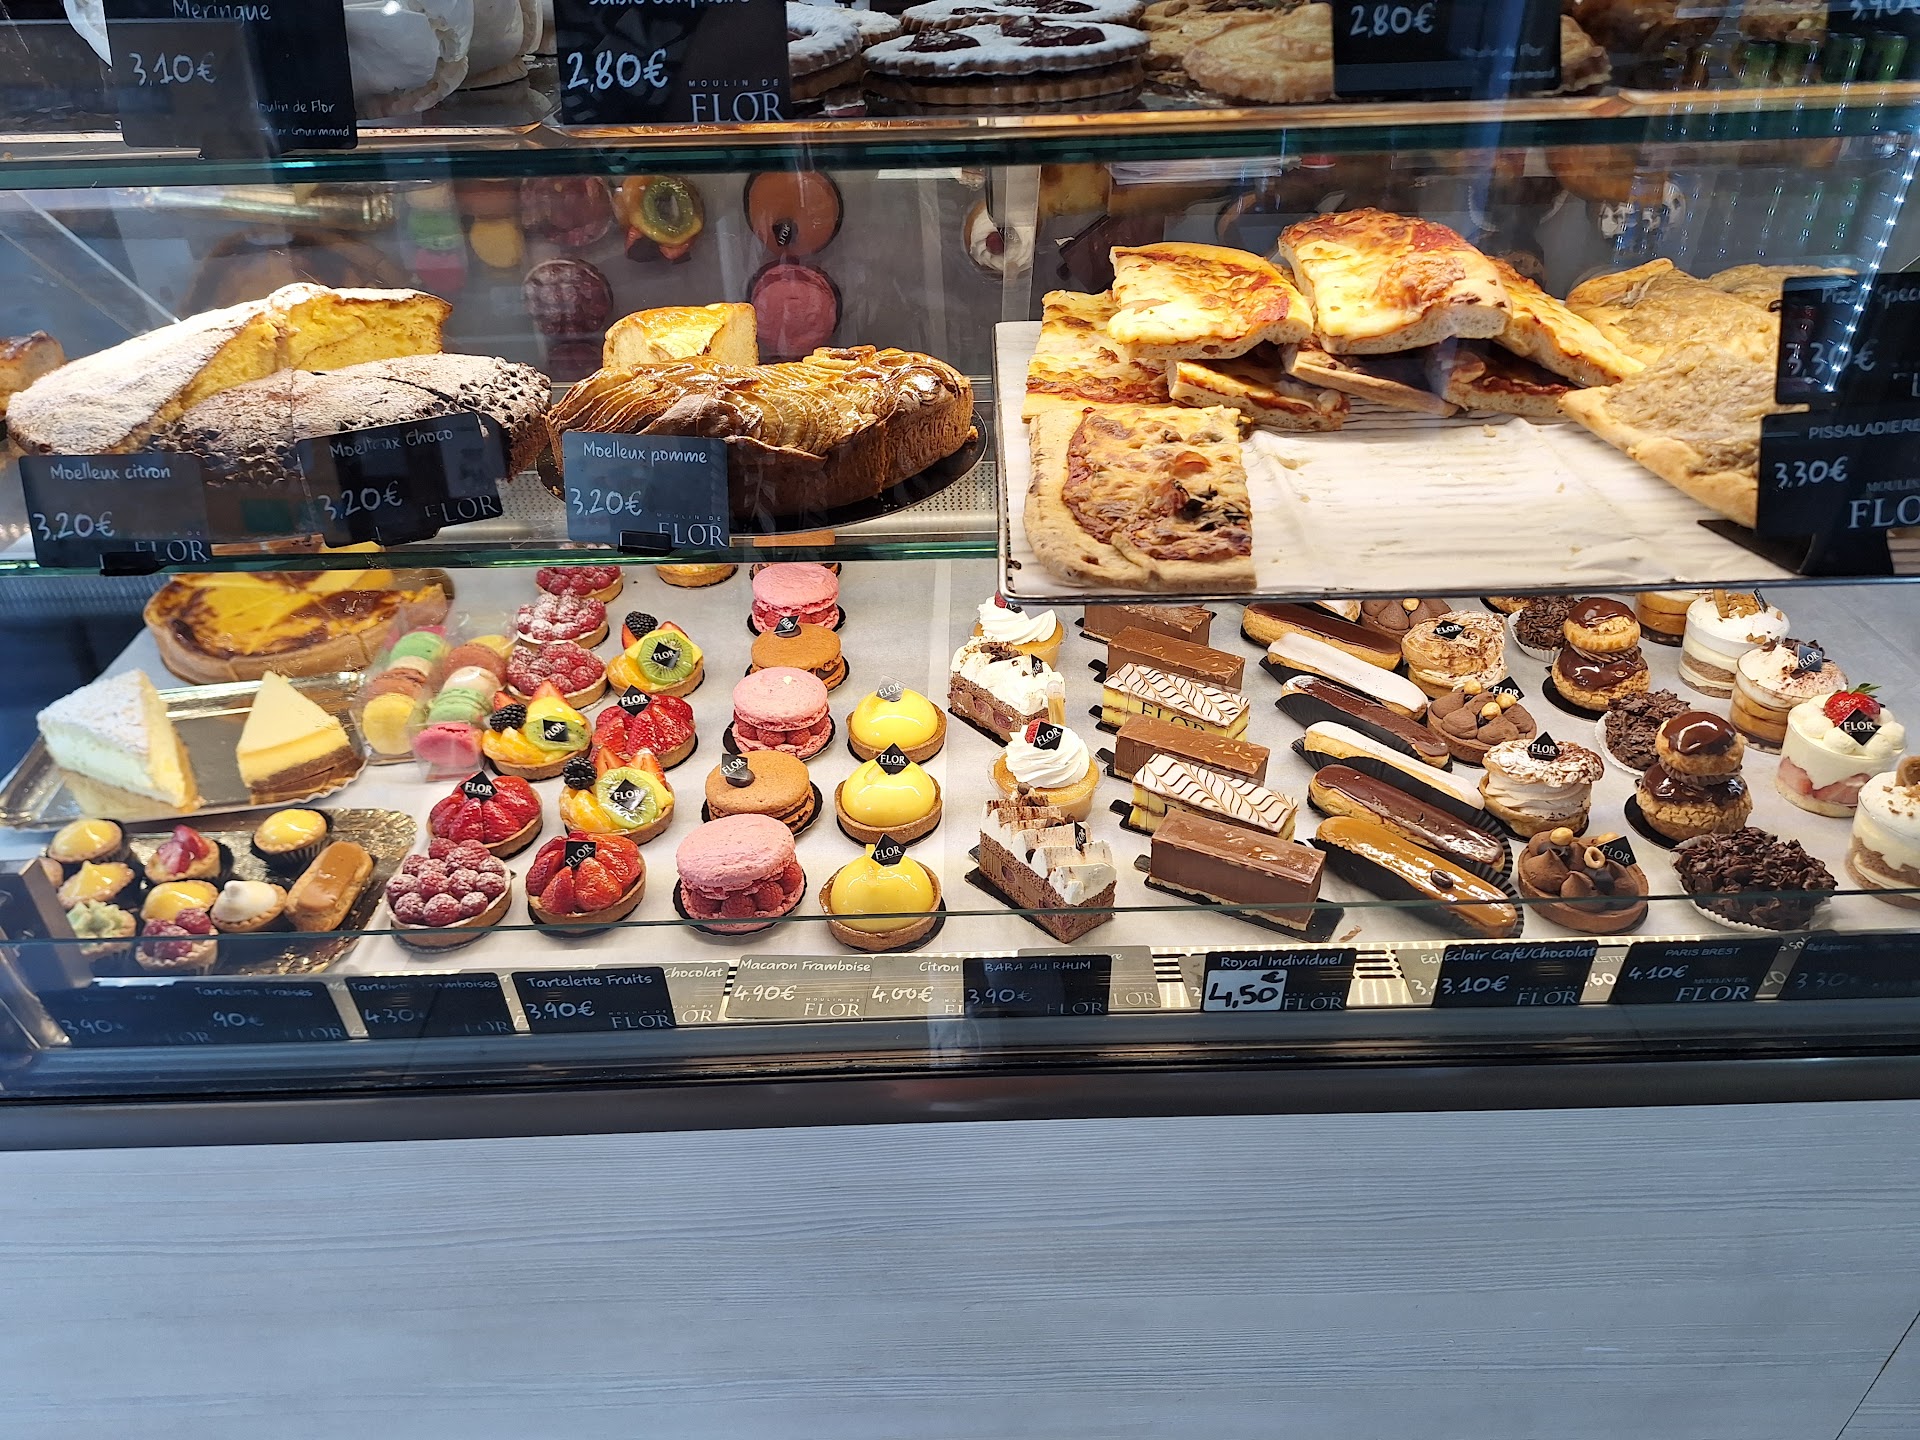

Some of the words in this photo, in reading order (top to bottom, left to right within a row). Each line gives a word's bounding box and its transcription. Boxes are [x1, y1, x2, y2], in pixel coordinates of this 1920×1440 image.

[172, 0, 272, 24] Meringue
[1350, 3, 1435, 36] 2,80€
[129, 52, 217, 86] 3,10€
[567, 49, 669, 93] 2,80€
[761, 78, 780, 87] DE
[256, 101, 289, 113] oulin
[292, 101, 308, 113] de
[311, 100, 336, 113] Flor
[690, 90, 785, 122] FLOR
[583, 442, 646, 461] Moelleux
[651, 448, 708, 466] pomme
[51, 464, 120, 480] Moelleux
[124, 464, 171, 479] citron
[1774, 456, 1849, 488] 3,30€
[318, 481, 402, 521] 3,20€
[570, 487, 642, 518] 3,20€
[33, 511, 116, 541] 3,20€
[658, 522, 726, 547] FLOR
[1436, 625, 1462, 635] FLOR
[653, 649, 677, 660] FLOR
[1799, 650, 1820, 670] FLOR
[878, 681, 901, 698] FLOR
[621, 694, 649, 705] FLOR
[545, 722, 565, 739] FLOR
[1843, 720, 1875, 732] FLOR
[1036, 727, 1063, 746] FLOR
[1531, 743, 1556, 755] FLOR
[721, 757, 745, 775] FLOR
[879, 754, 906, 765] FLOR
[464, 782, 493, 794] FLOR
[613, 789, 641, 800] FLOR
[566, 844, 595, 868] FLOR
[874, 844, 902, 860] FLOR
[1601, 845, 1631, 864] FLOR
[1444, 949, 1489, 961] Eclair
[1491, 946, 1596, 963] Café/Chocolat
[1665, 948, 1699, 957] PARIS
[1701, 947, 1740, 956] BREST
[739, 959, 798, 971] Macaron
[801, 961, 871, 972] Framboise
[918, 960, 960, 973] Citron
[985, 962, 1024, 973] BABA
[1029, 962, 1048, 971] AU
[1053, 960, 1091, 971] RHUM
[1220, 955, 1263, 970] Royal
[1268, 953, 1343, 967] Individuel
[526, 975, 603, 988] Tartelette
[606, 973, 653, 985] Fruits
[664, 966, 724, 978] Chocolat
[1628, 965, 1689, 980] 4,10€
[733, 984, 798, 1003] 4,90€
[1441, 975, 1509, 995] 3,10€
[1675, 985, 1750, 1002] FLOR
[871, 985, 934, 1003] 4,00€
[968, 988, 1032, 1005] 3,90€
[1516, 990, 1577, 1005] FLOR
[526, 1000, 596, 1020] 3,90€
[803, 1002, 861, 1017] FLOR
[1047, 1001, 1104, 1015] FLOR
[1284, 996, 1344, 1011] FLOR
[611, 1014, 675, 1029] FLOR
